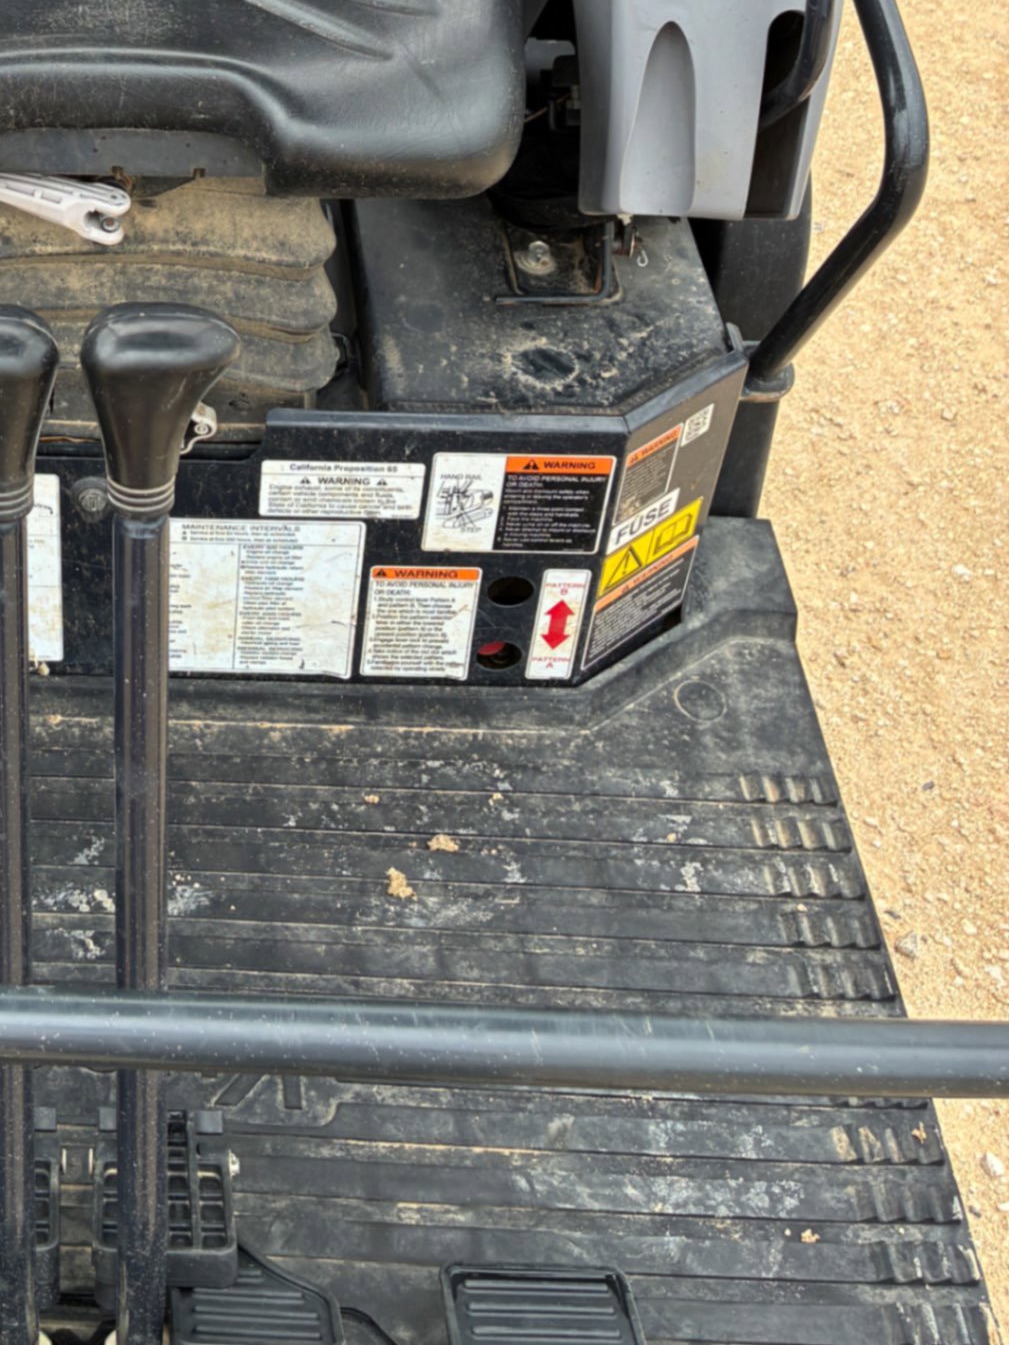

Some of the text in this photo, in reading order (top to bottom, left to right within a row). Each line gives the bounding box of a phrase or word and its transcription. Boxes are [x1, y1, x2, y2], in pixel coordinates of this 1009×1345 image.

[290, 464, 331, 472] California
[334, 464, 385, 473] Proposition
[544, 461, 595, 470] WARNING
[318, 477, 371, 486] WARNING
[615, 498, 673, 546] FUSE
[182, 524, 246, 532] MAINTENANCE
[394, 570, 458, 578] WARNING
